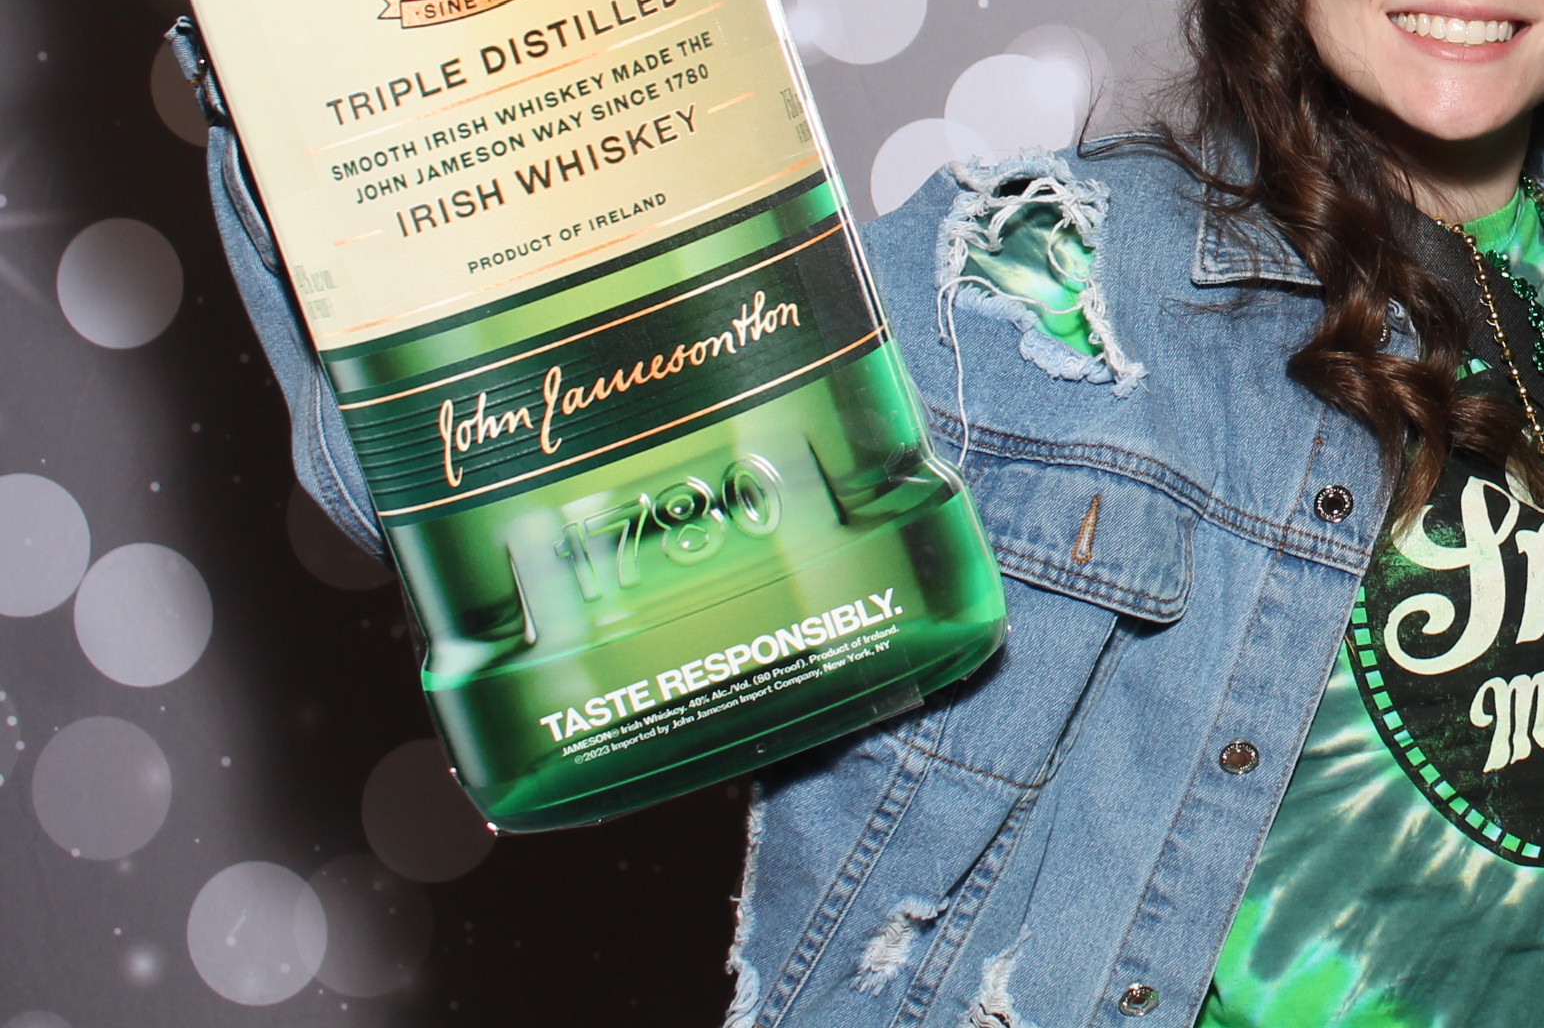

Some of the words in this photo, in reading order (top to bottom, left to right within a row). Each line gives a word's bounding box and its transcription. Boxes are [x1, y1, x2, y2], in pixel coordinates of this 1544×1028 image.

[326, 58, 468, 127] TRIPLE
[331, 140, 418, 182] SMOOTH
[425, 115, 489, 152] IRISH
[494, 72, 605, 126] WHISKEY
[611, 47, 674, 84] MADE
[676, 30, 714, 58] THE
[356, 173, 409, 205] JOHN
[416, 133, 526, 186] JAMESON
[531, 111, 584, 142] WAY
[591, 83, 660, 122] SINCE
[665, 63, 710, 94] 1780
[396, 178, 506, 238] IRISH
[515, 104, 698, 195] WHISKEY
[467, 234, 553, 274] PRODUCT
[559, 223, 583, 242] OF
[588, 192, 667, 232] IRELAND
[439, 398, 534, 488] John
[553, 452, 784, 604] 1780
[539, 679, 656, 743] TASTE
[656, 587, 904, 702] RESPONSIBLY.
[611, 728, 656, 752] Imported
[657, 724, 670, 735] by
[671, 715, 695, 730] John
[696, 697, 739, 720] Jameson
[739, 684, 773, 704] Import
[773, 668, 823, 691] Company,
[822, 658, 846, 673] New
[847, 648, 875, 663] York,
[875, 640, 891, 654] NY
[620, 720, 643, 735] Irish
[642, 705, 688, 726] Whiskey.
[688, 693, 711, 709] 40%
[752, 673, 772, 687] (80
[773, 658, 808, 678] Proof).
[808, 642, 850, 665] Product
[851, 636, 862, 649] of
[863, 623, 900, 645] Ireland.
